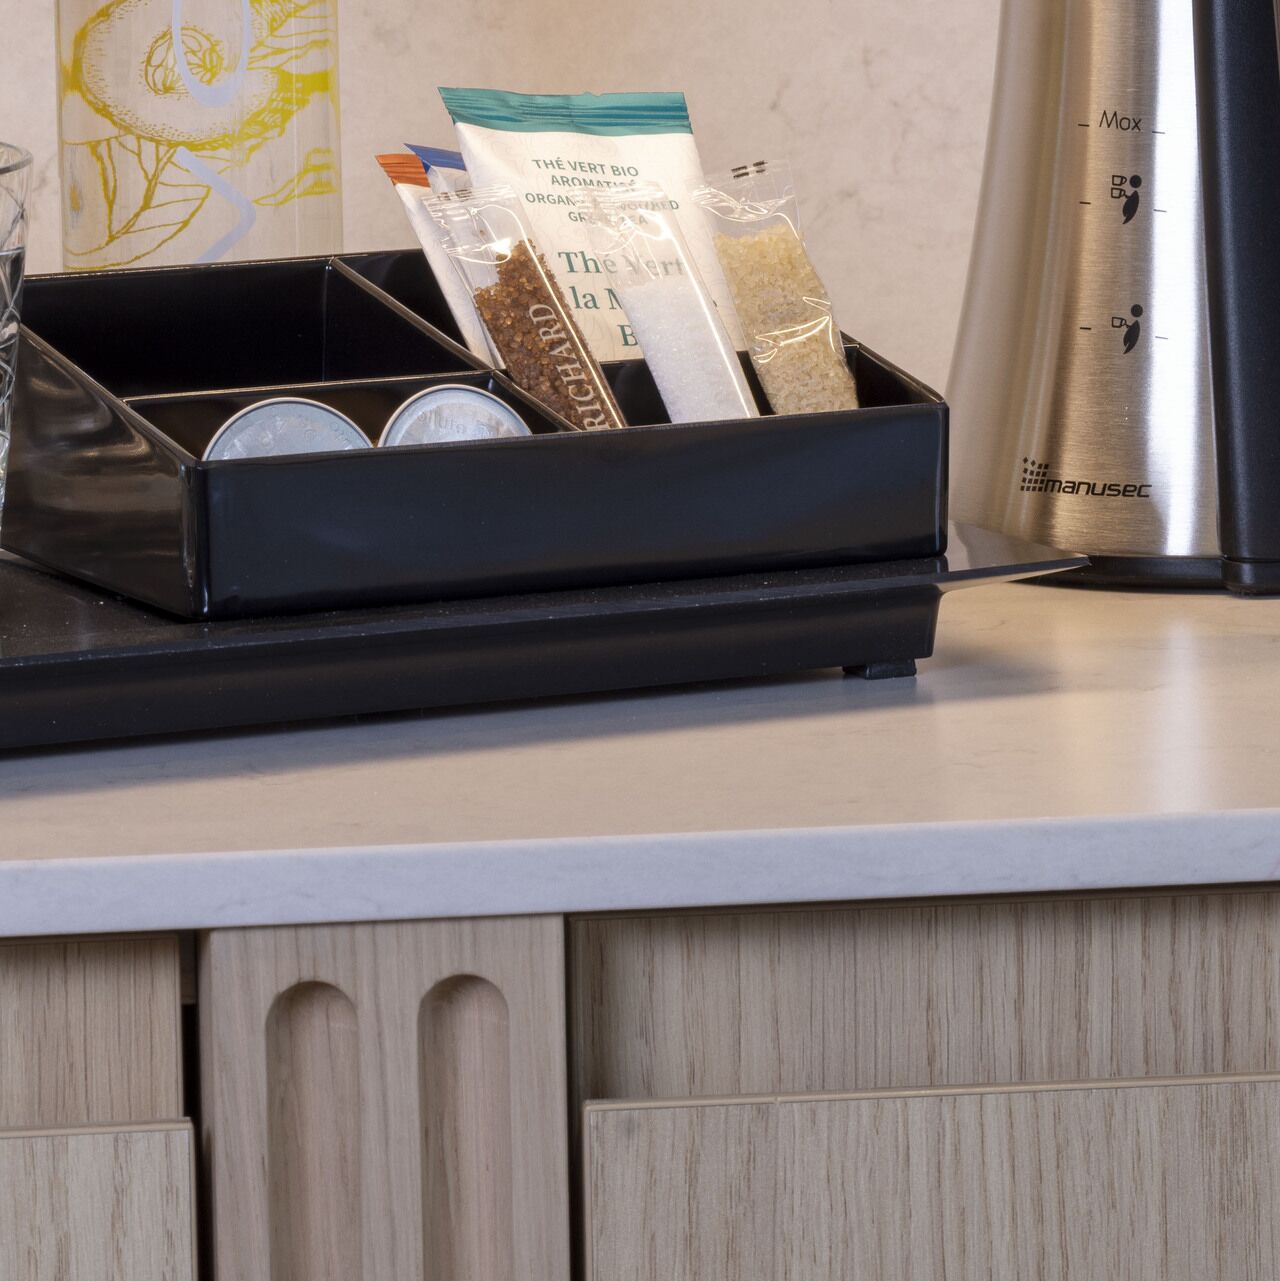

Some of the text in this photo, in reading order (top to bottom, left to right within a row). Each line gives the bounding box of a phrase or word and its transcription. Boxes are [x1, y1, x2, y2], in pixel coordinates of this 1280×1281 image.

[532, 157, 639, 177] THÉ VERT BIO
[558, 251, 617, 274] Thé
[569, 286, 600, 310] la
[528, 303, 611, 431] RICHARD
[1044, 477, 1153, 499] manusec
